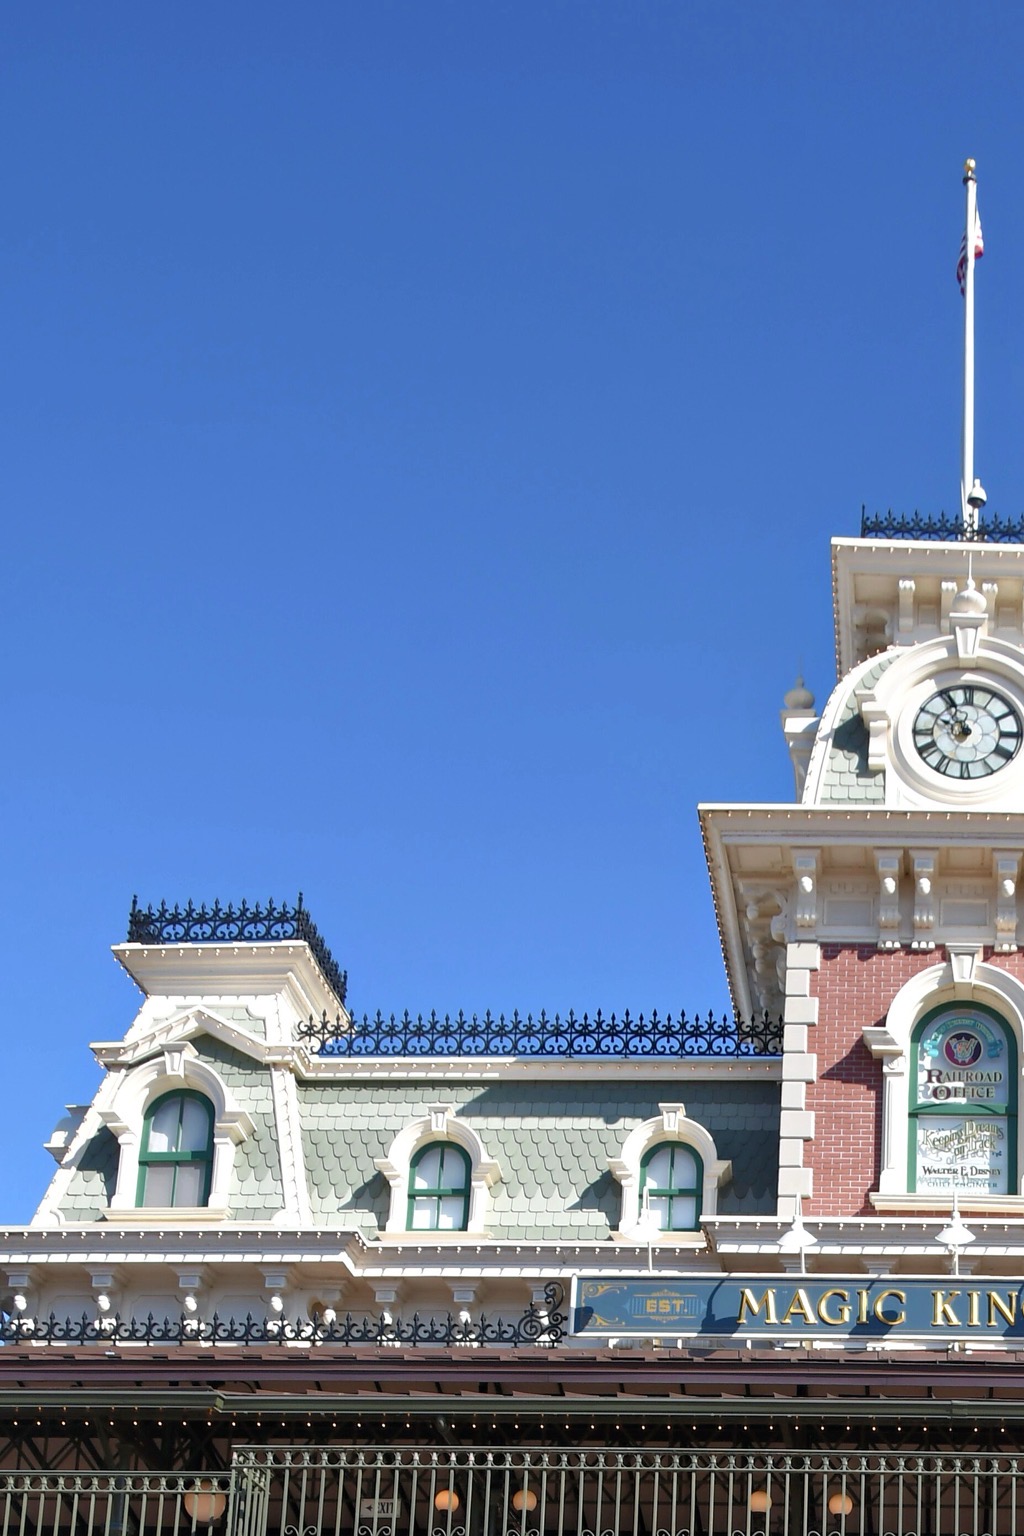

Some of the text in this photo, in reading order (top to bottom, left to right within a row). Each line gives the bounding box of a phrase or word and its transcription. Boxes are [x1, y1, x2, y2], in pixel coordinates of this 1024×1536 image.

[925, 1068, 1003, 1084] RAILROAD
[932, 1085, 995, 1101] OFFICE
[922, 1165, 959, 1176] WALTER
[970, 1165, 1001, 1176] DISNEY
[645, 1298, 688, 1313] EST.
[736, 1288, 907, 1325] MAGIC
